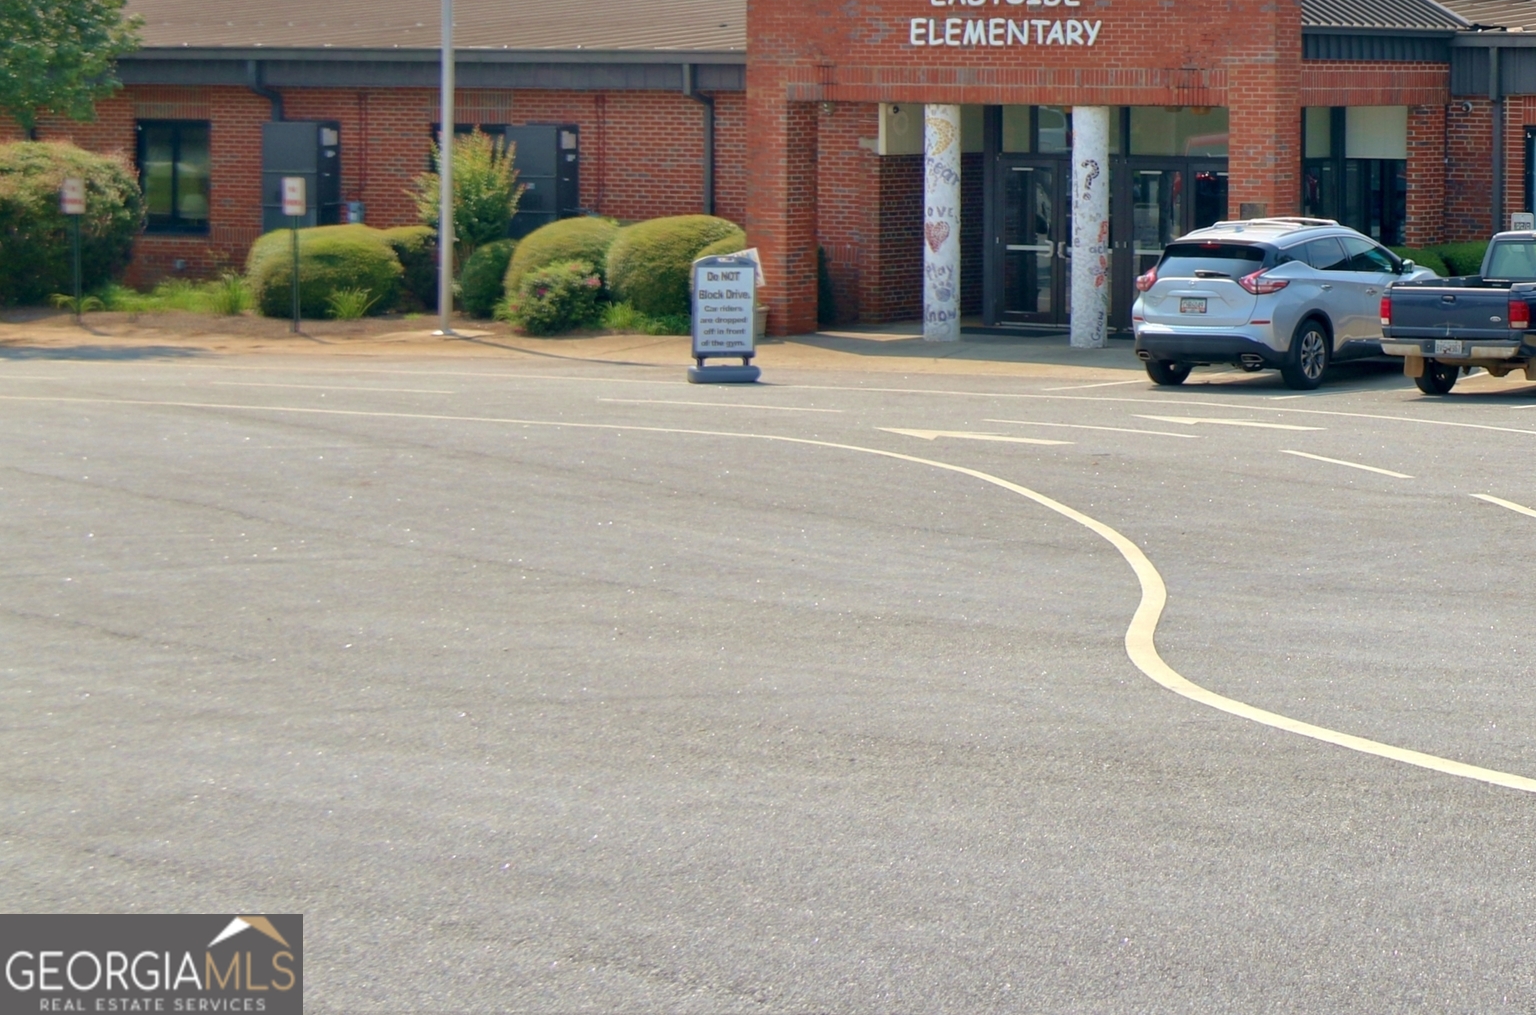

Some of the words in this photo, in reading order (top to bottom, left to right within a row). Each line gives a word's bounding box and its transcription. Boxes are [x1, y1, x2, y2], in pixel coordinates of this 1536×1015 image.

[910, 18, 1102, 46] ELEMENTARY
[925, 207, 954, 218] OVE
[707, 271, 719, 281] Do
[721, 271, 741, 281] NOT
[699, 289, 723, 300] Block
[725, 289, 751, 300] Drive.
[715, 316, 747, 325] dropped
